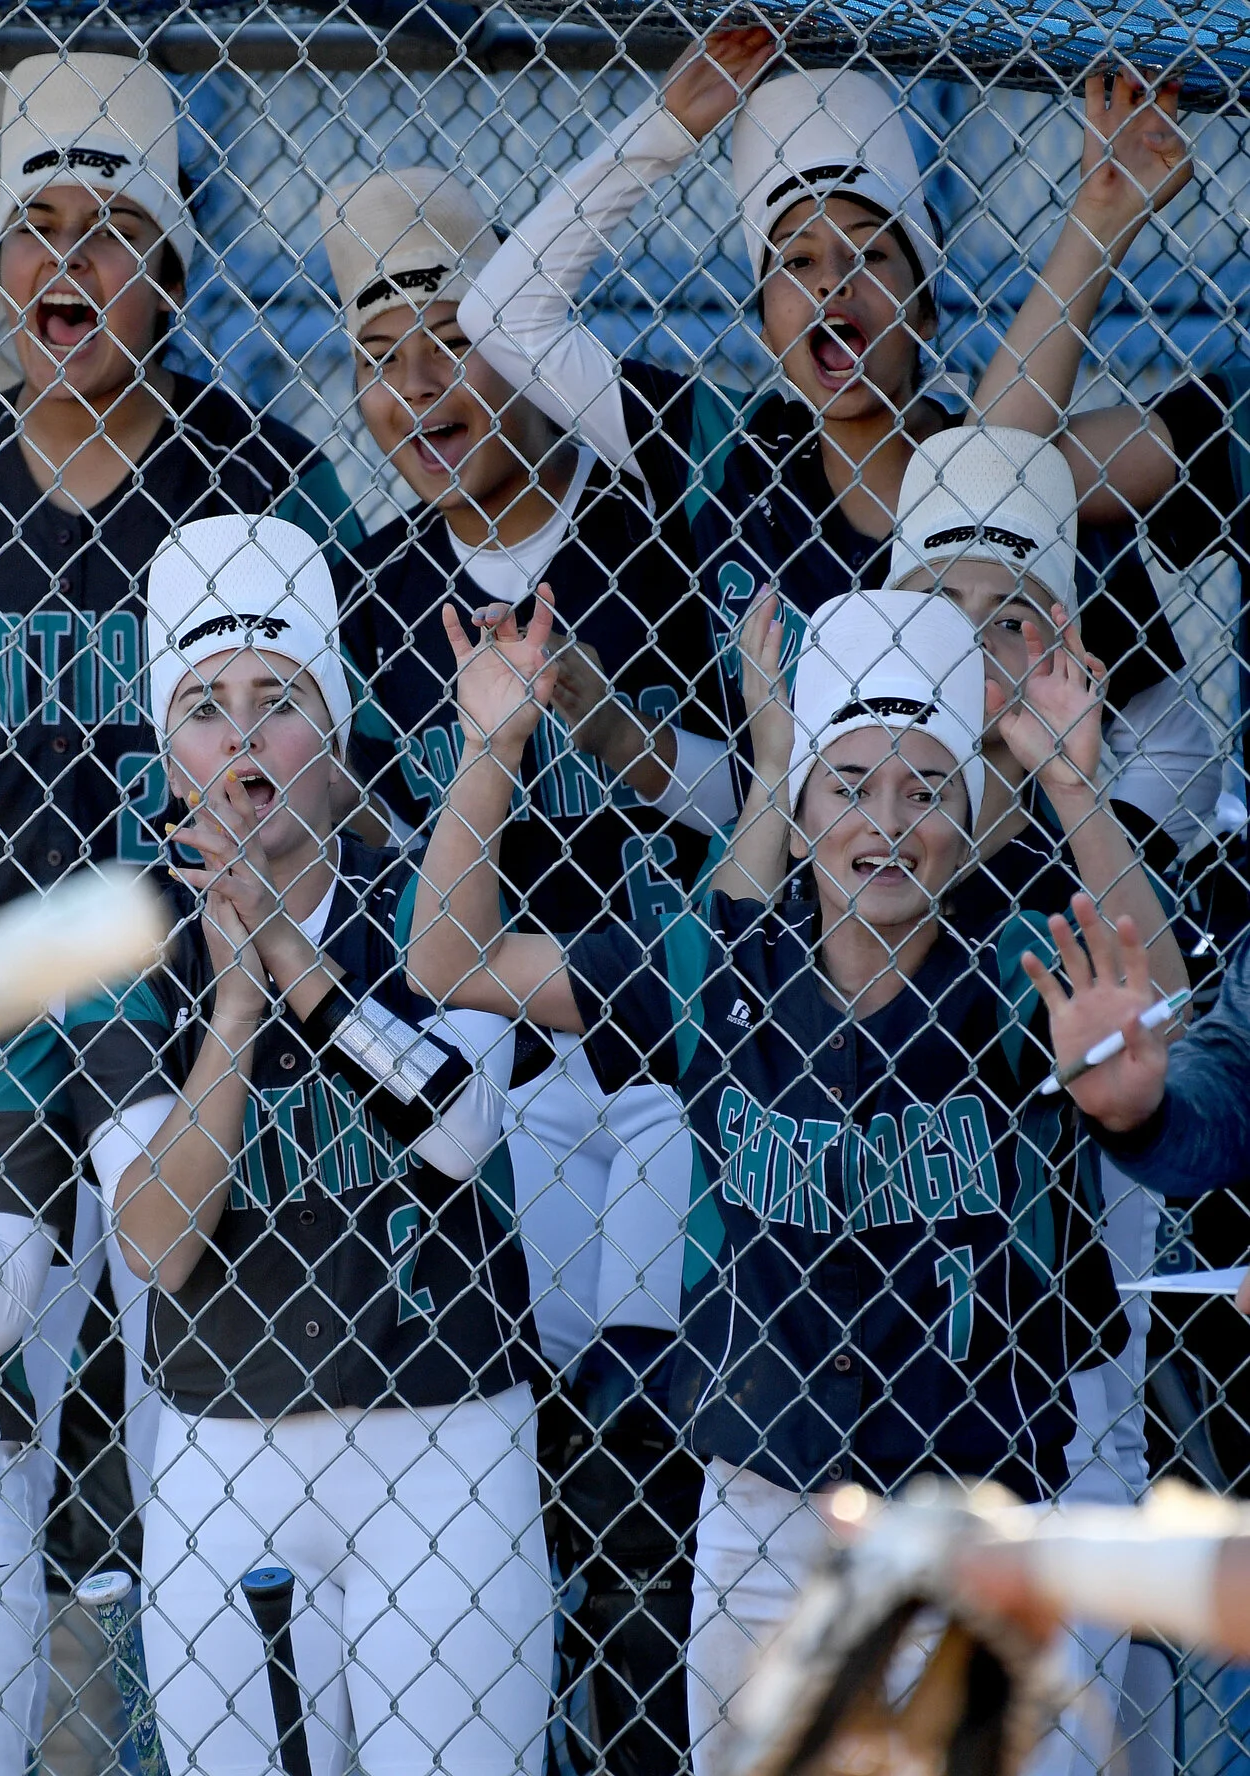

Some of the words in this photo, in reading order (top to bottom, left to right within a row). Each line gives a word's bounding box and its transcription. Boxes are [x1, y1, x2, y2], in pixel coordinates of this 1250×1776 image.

[717, 1086, 1001, 1233] SANTIAGO
[387, 1202, 436, 1326] 2
[934, 1245, 977, 1362] 1
